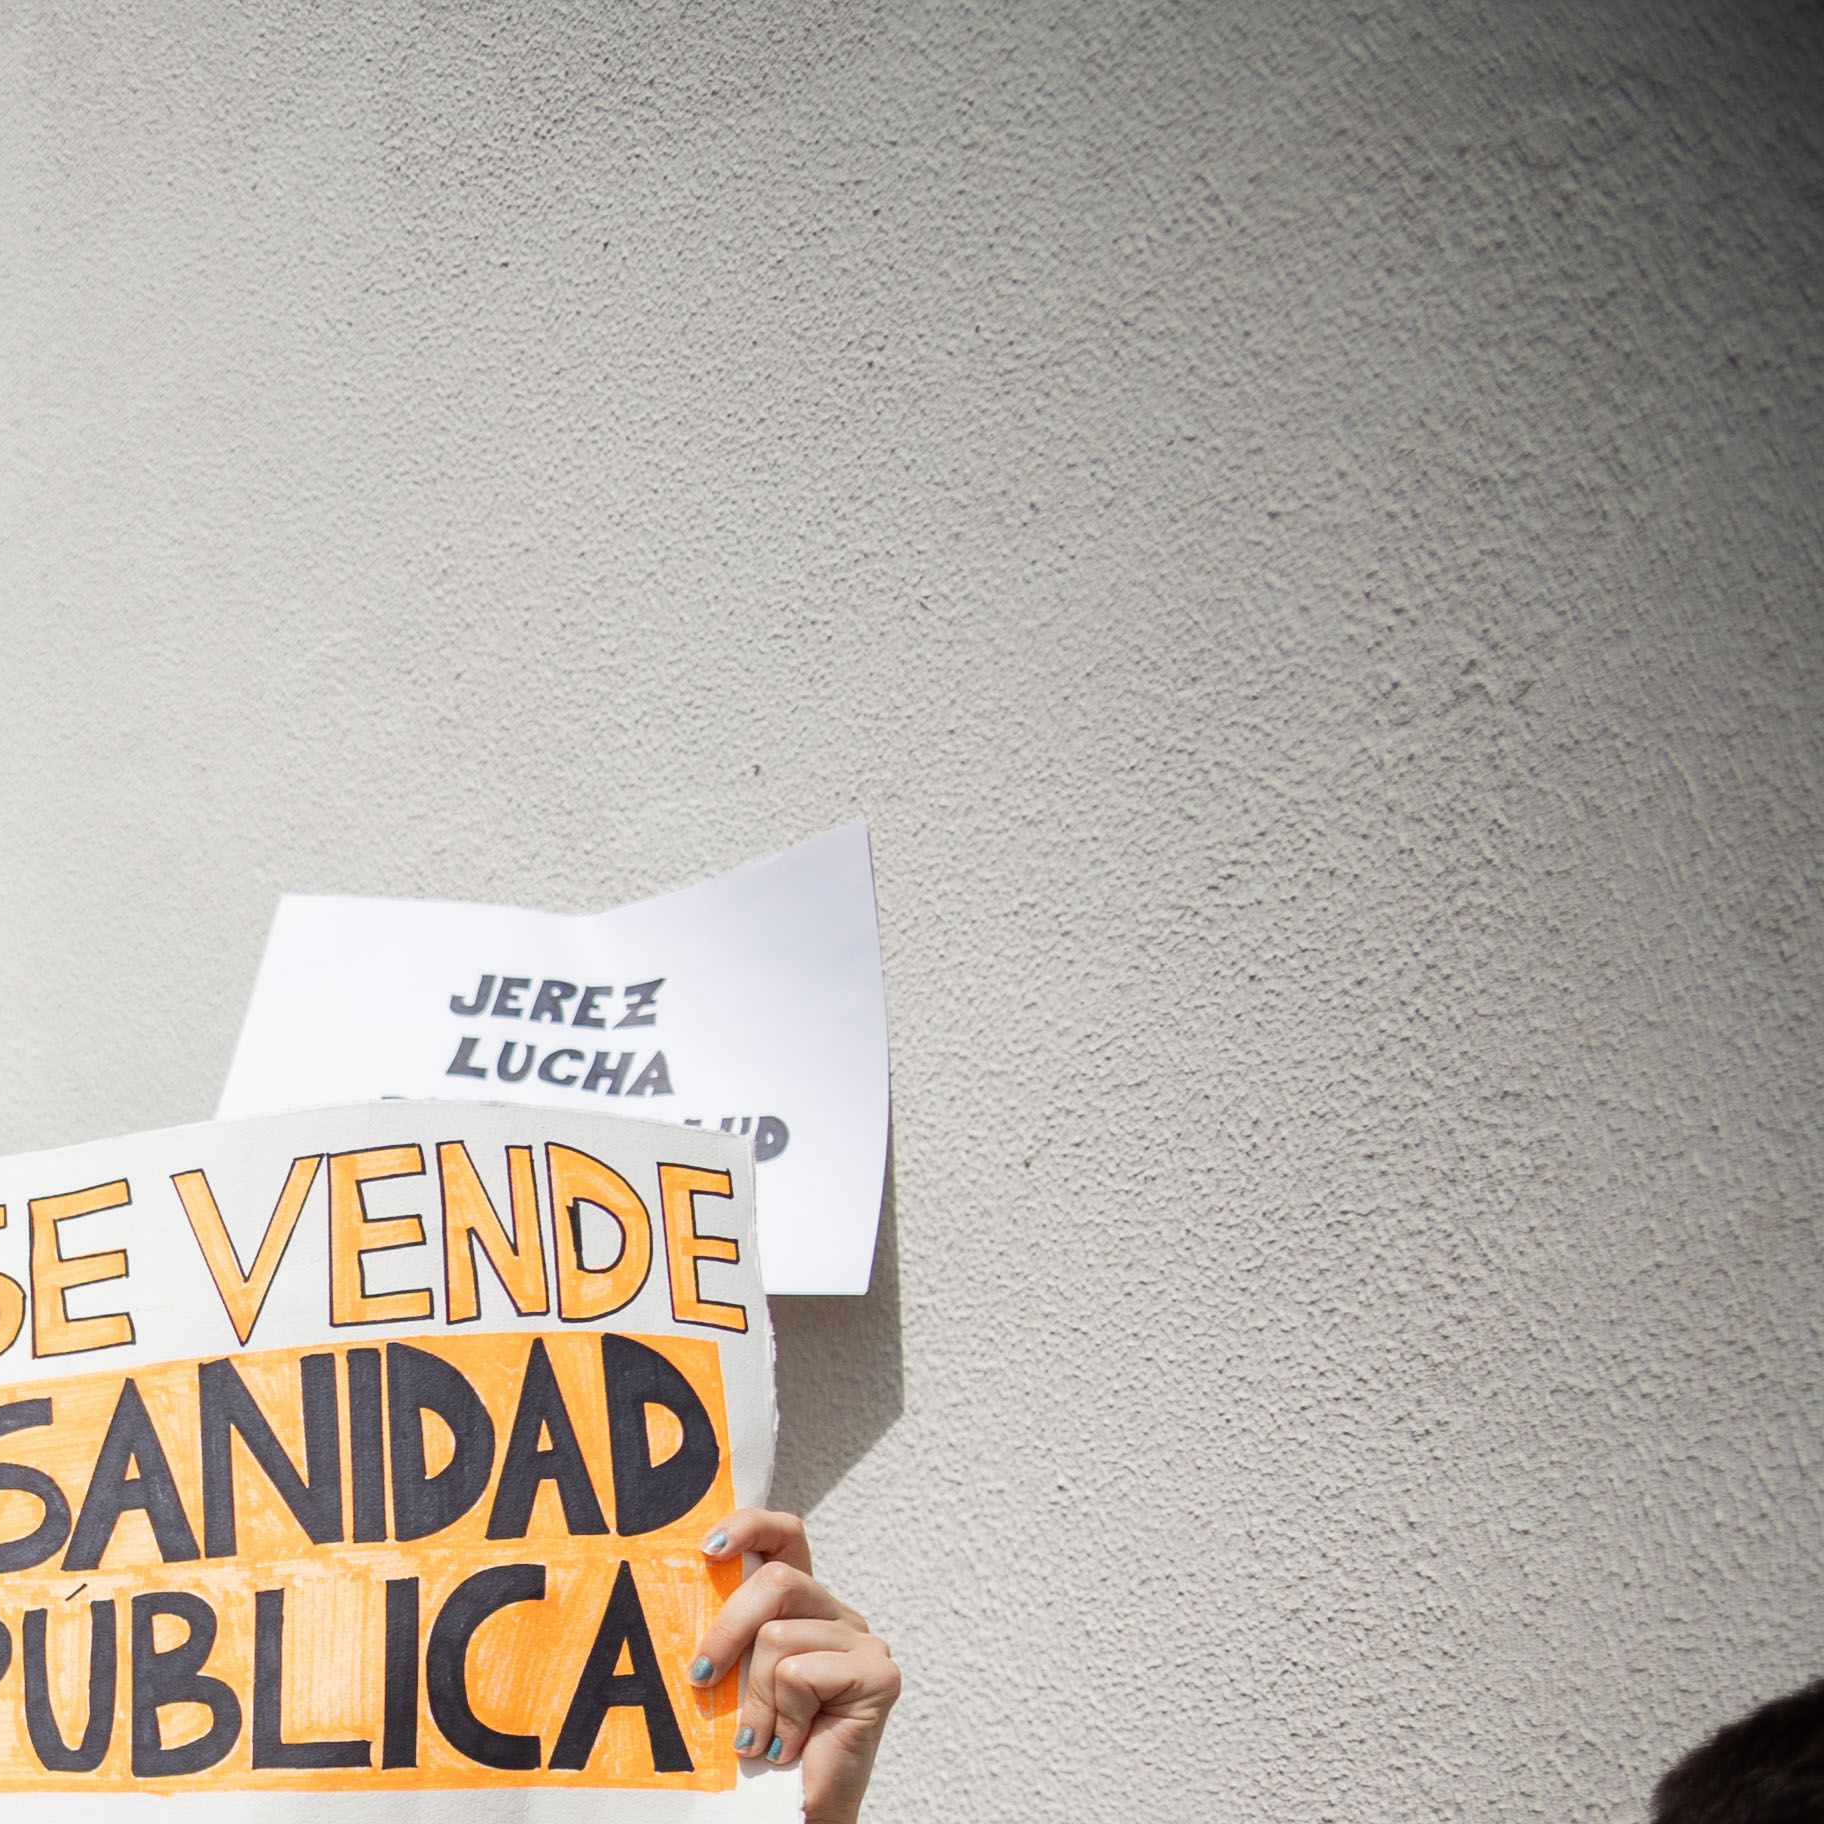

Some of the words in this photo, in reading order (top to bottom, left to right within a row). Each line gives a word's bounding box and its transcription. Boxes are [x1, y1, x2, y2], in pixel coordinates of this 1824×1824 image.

[449, 974, 667, 1030] JEREZ
[445, 1036, 675, 1096] LUCHA
[168, 1139, 750, 1346] VENDE
